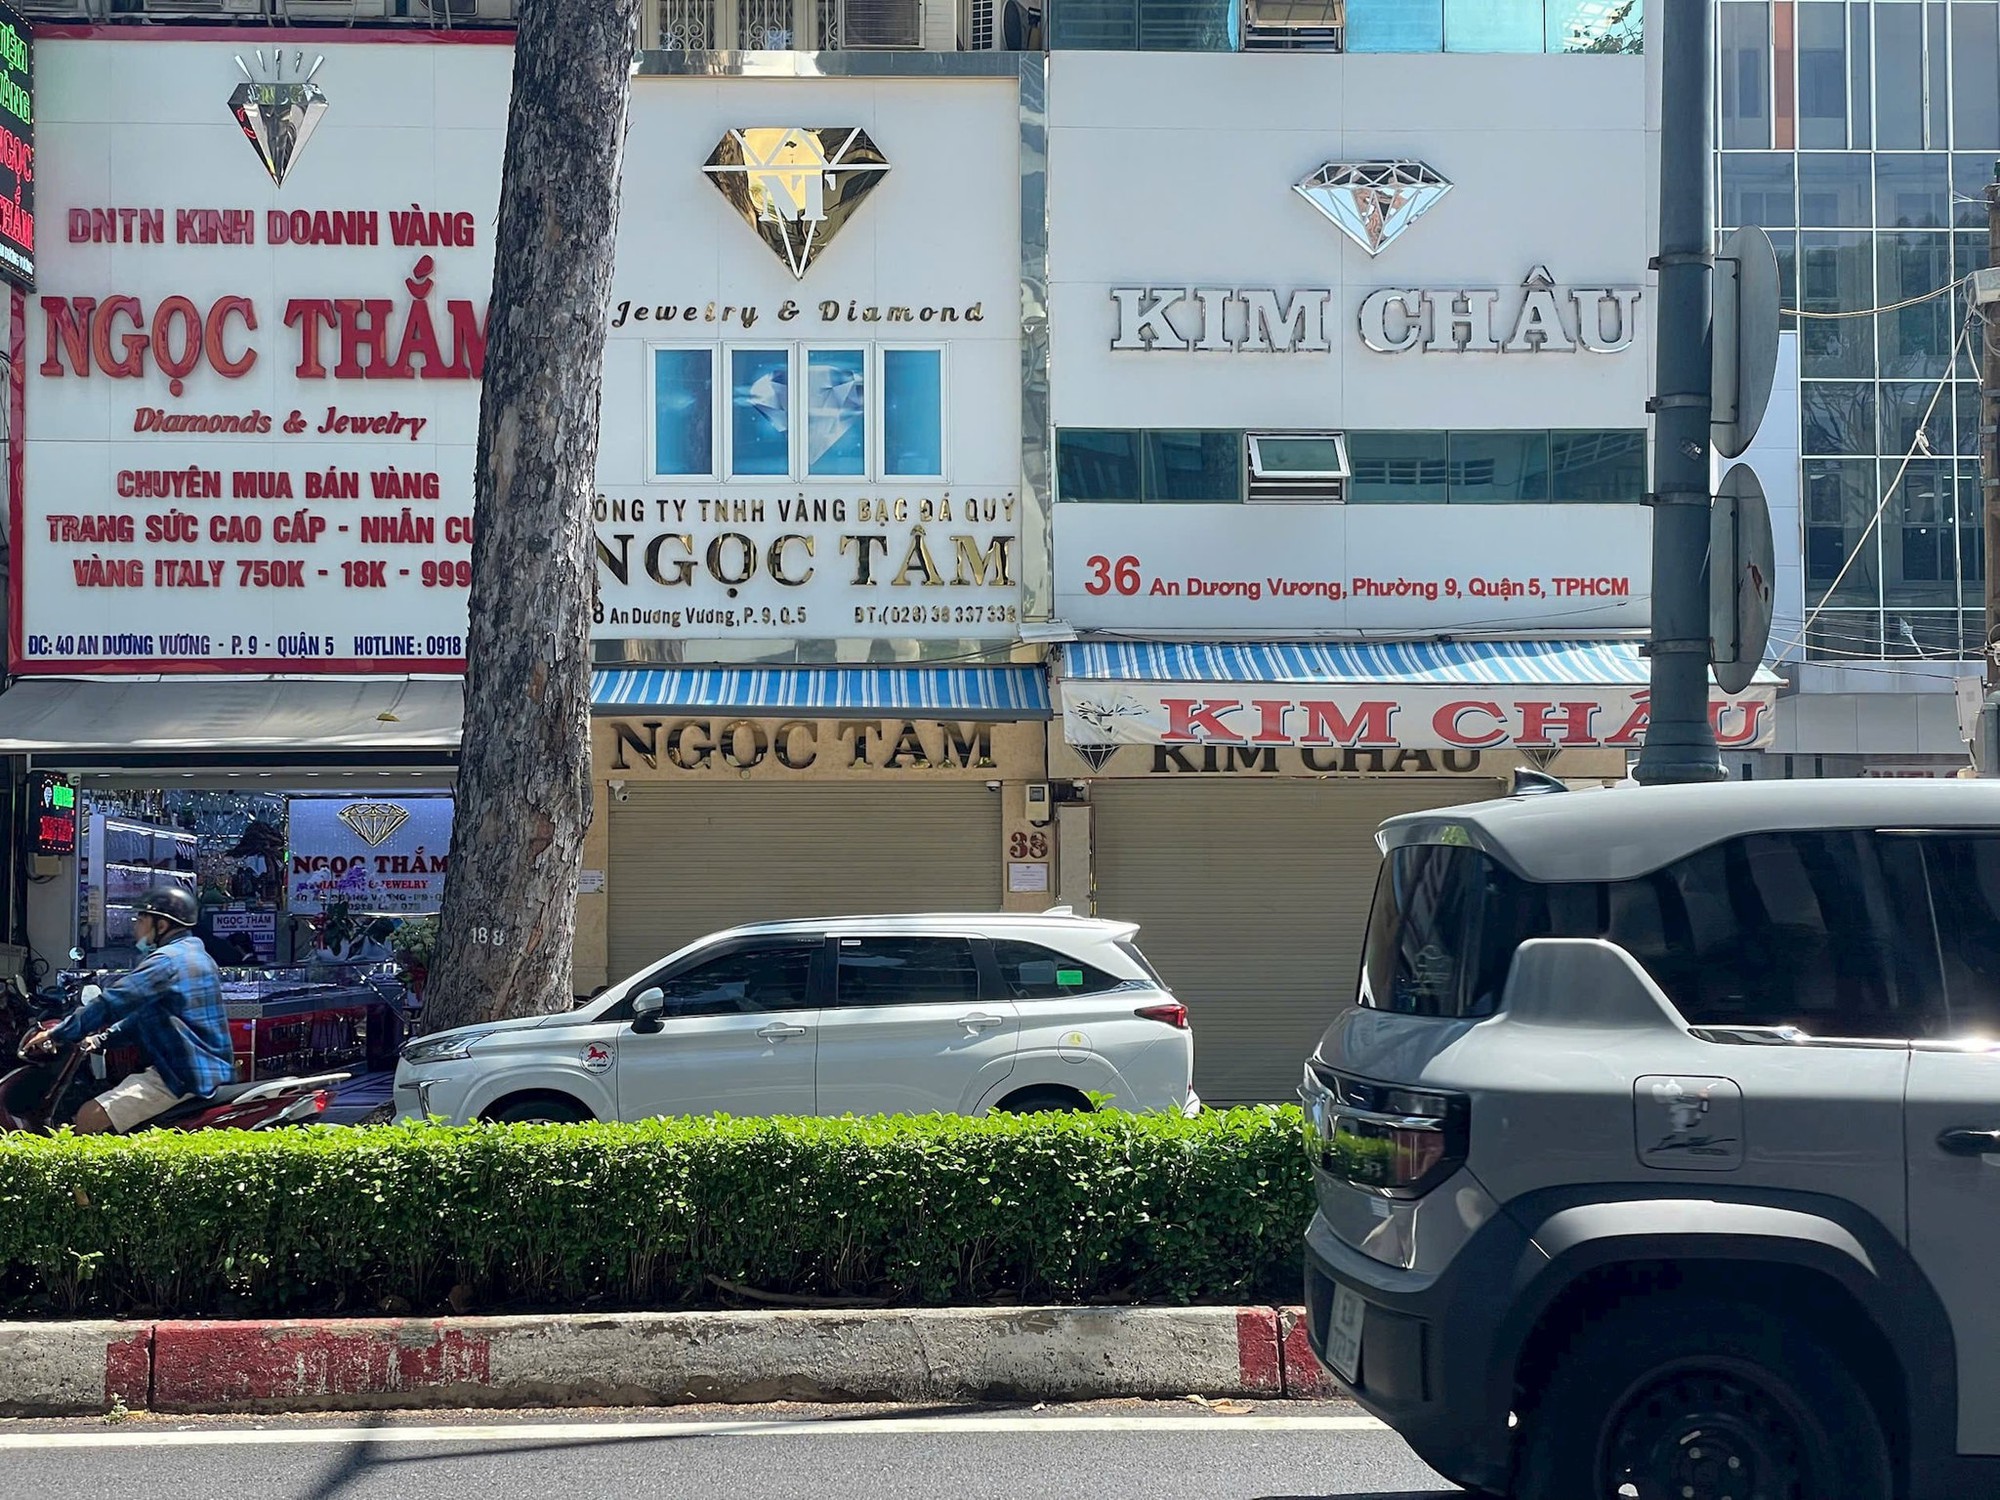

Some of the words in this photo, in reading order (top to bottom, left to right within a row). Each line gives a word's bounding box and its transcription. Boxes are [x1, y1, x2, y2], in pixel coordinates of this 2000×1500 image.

[0, 69, 31, 125] ÀNG
[0, 126, 32, 184] GỌC
[68, 208, 164, 244] DNTN
[176, 208, 255, 245] KINH
[267, 210, 379, 247] DOANH
[389, 203, 475, 247] VÀNG
[40, 295, 258, 398] NGỌC
[283, 254, 492, 379] THẮM
[611, 300, 758, 328] Jewelry
[777, 300, 800, 322] &
[818, 300, 984, 322] Diamond
[1110, 287, 1331, 352] KIM
[1358, 265, 1642, 354] CHÂU
[133, 407, 271, 434] Diamonds
[283, 410, 307, 434] &
[318, 406, 426, 441] Jewelry
[117, 464, 221, 499] CHUYÊN
[232, 471, 294, 499] MUA
[305, 466, 359, 500] BÁN
[370, 466, 440, 500] VÀNG
[46, 514, 134, 542] TRANG
[145, 508, 198, 543] SỨC
[209, 515, 262, 543] CAO
[273, 508, 326, 543] CẤP
[360, 507, 434, 543] NHẪN
[594, 493, 645, 522] ÔNG
[656, 500, 686, 523] TY
[699, 499, 764, 522] TNHH
[778, 492, 846, 522] VÀNG
[857, 498, 908, 527] BẠC
[919, 492, 952, 522] ĐÁ
[965, 492, 1016, 522] QUÝ
[73, 553, 144, 587] VÀNG
[154, 560, 225, 587] ITALY
[236, 560, 305, 587] 750K
[340, 560, 387, 587] 18K
[595, 532, 815, 599] NGỌC
[839, 524, 1016, 587] TÂM
[1084, 555, 1141, 596] 36
[1149, 578, 1180, 596] An
[1186, 578, 1261, 600] Dương
[1266, 578, 1348, 600] Vương,
[1352, 577, 1438, 601] Phường
[1444, 578, 1463, 599] 9,
[1468, 577, 1524, 602] Quận
[1528, 578, 1547, 599] 5,
[1551, 578, 1629, 596] TPHCM
[610, 607, 629, 624] An
[632, 607, 681, 628] Dương
[685, 606, 740, 628] Vương,
[28, 635, 53, 655] ĐC:
[56, 636, 74, 655] 40
[77, 636, 98, 655] AN
[102, 633, 153, 655] DƯƠNG
[159, 634, 210, 655] VƯƠNG
[277, 632, 320, 658] QUẬN
[325, 637, 334, 655] 5
[426, 636, 461, 655] 0918
[1160, 699, 1402, 749] KIM
[1150, 744, 1280, 773] KIM
[374, 846, 449, 874] THẮM
[1009, 831, 1049, 859] 38
